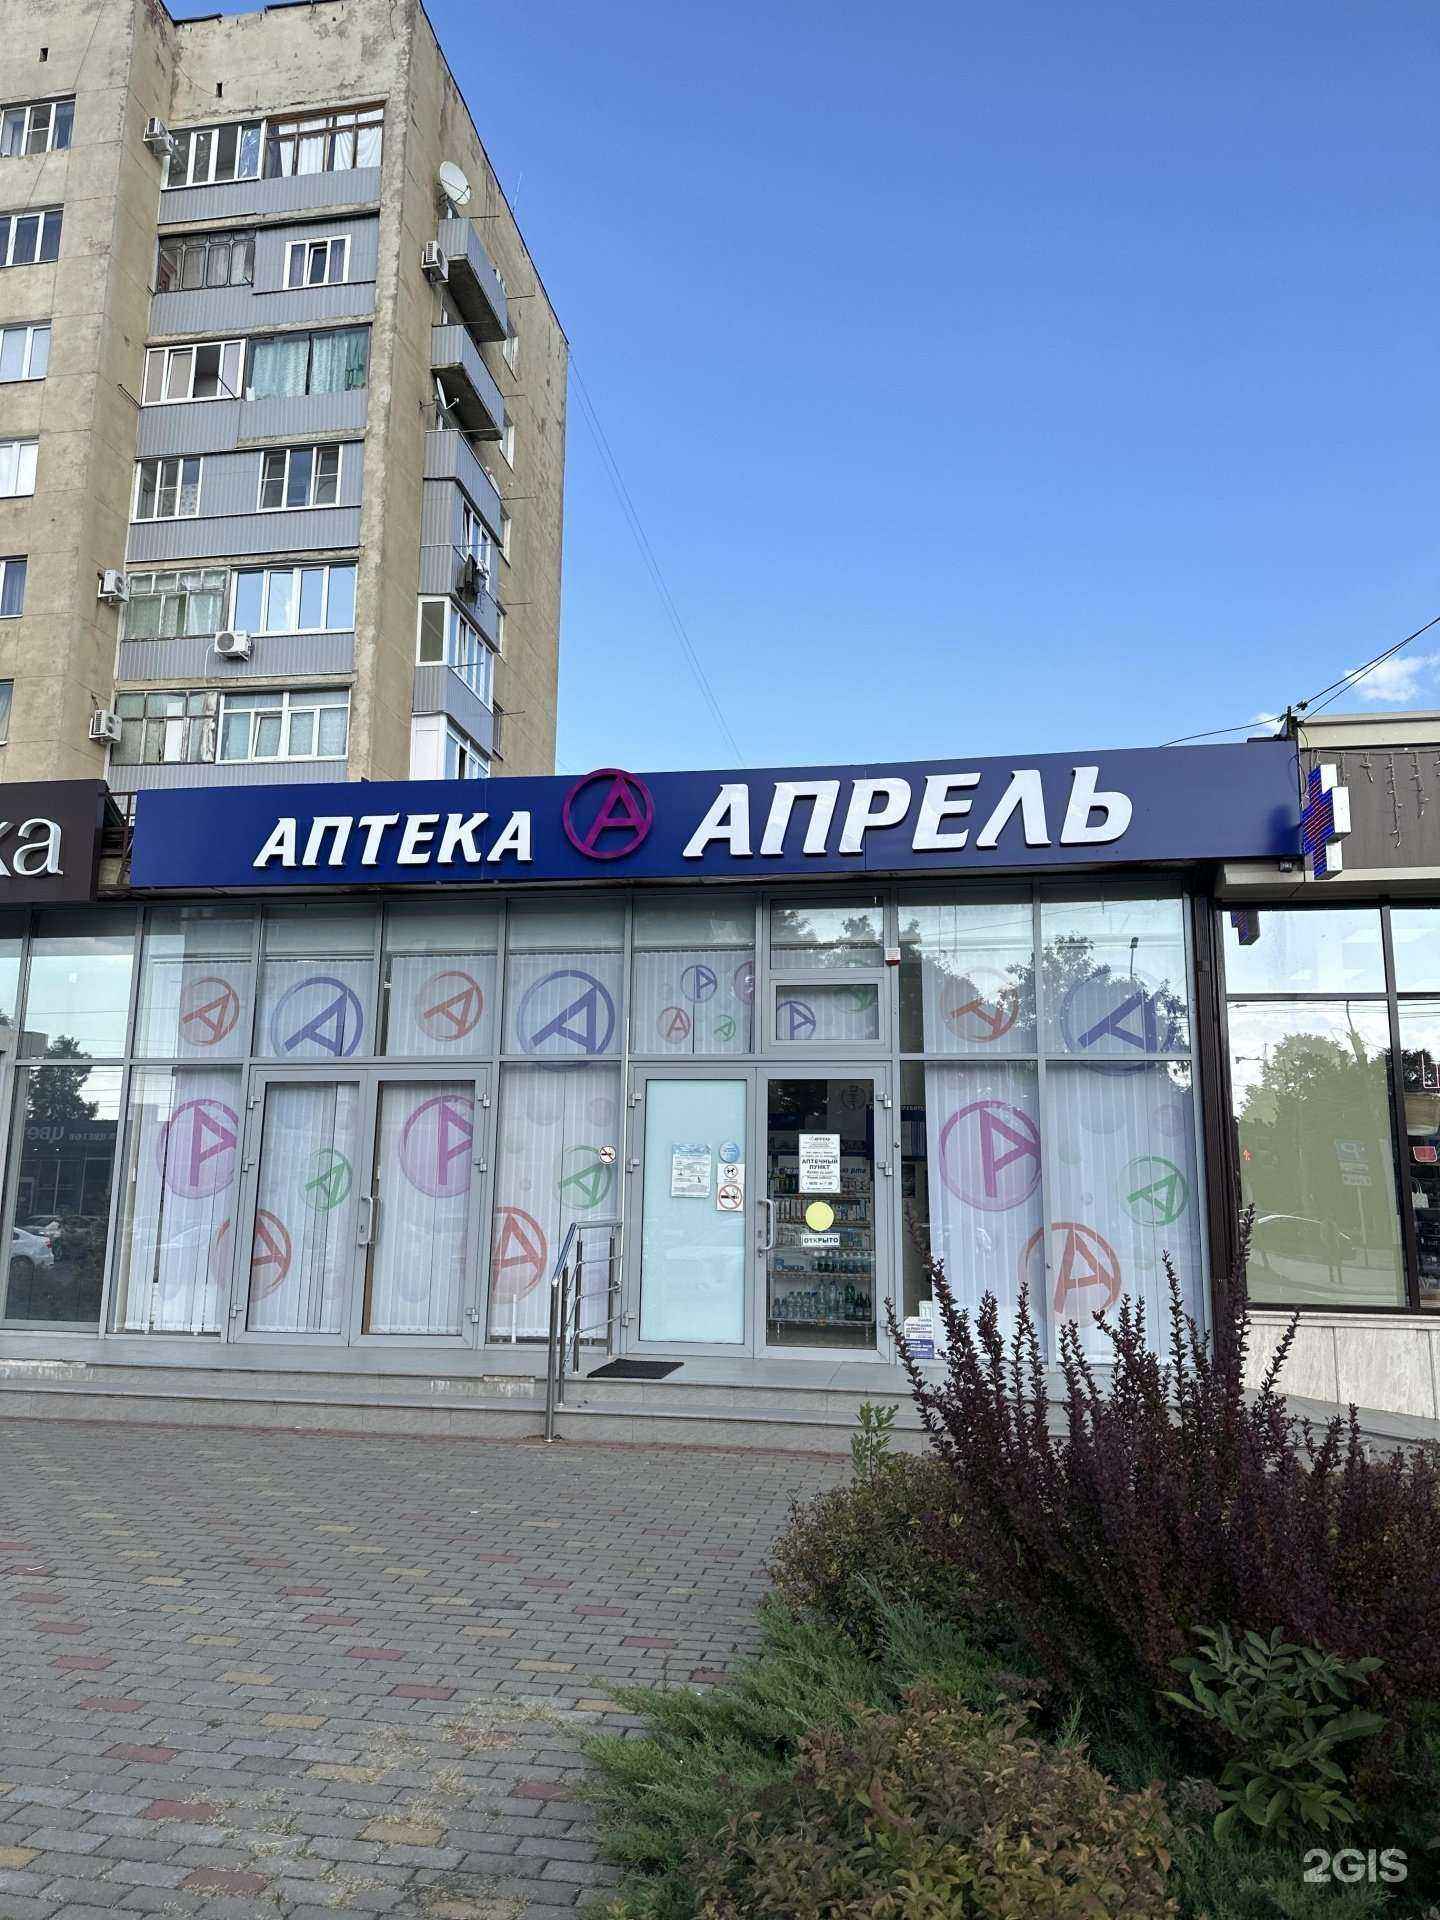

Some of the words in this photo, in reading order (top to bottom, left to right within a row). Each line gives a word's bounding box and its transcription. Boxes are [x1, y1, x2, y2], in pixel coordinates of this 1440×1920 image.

[0, 818, 64, 877] а
[252, 811, 533, 868] АПТЕКА
[682, 766, 1133, 857] АПРЕЛЬ
